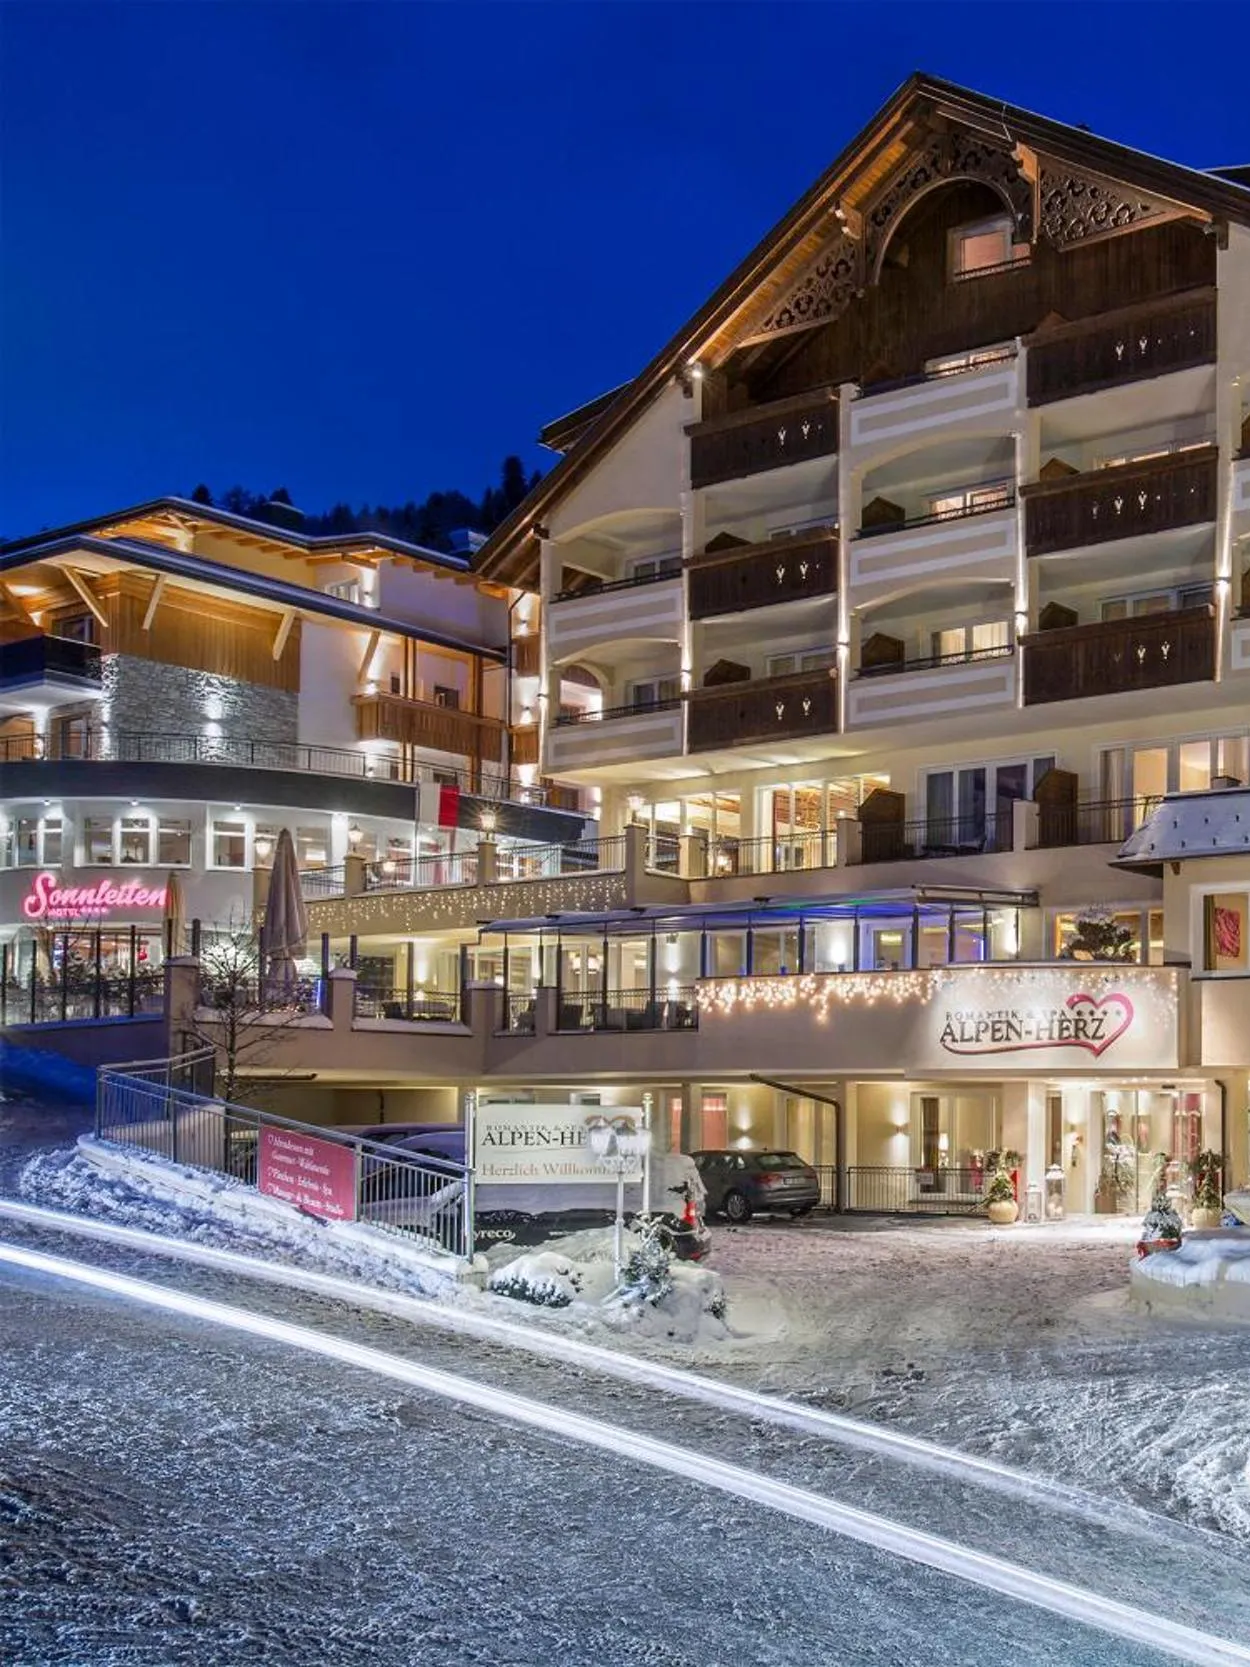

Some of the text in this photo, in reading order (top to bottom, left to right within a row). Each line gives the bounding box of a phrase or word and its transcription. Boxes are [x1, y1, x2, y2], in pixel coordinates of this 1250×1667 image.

[24, 872, 167, 917] Sonnleiten
[940, 1018, 1106, 1044] ALPEN-HERZ
[481, 1131, 589, 1146] ALPEN-HE
[481, 1162, 636, 1177] Herzlich Willkomm
